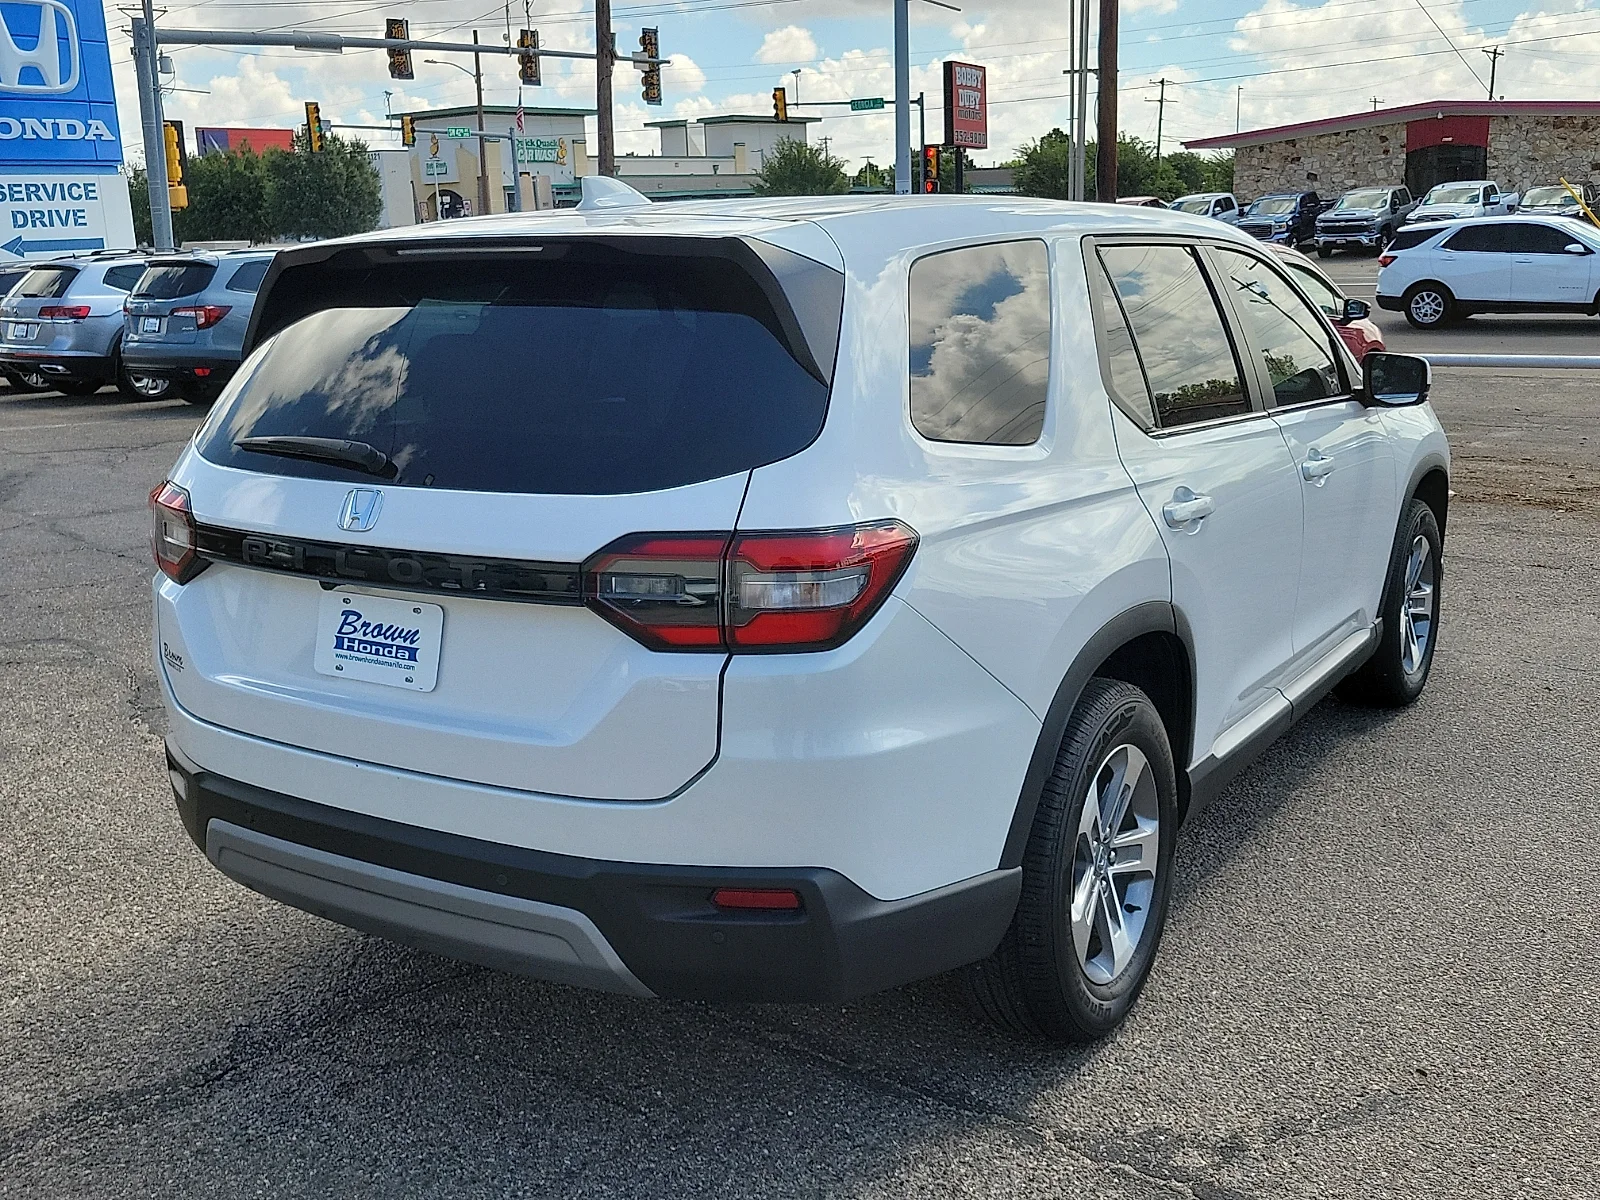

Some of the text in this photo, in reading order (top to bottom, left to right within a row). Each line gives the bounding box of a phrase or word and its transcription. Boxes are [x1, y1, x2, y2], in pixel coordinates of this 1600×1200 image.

[955, 66, 983, 89] BOBBY
[957, 88, 981, 110] DUBY
[0, 117, 116, 140] ONDA
[534, 148, 558, 161] WASH
[11, 209, 87, 229] DRIVE
[242, 537, 487, 589] PILOT
[336, 609, 421, 645] Brown
[343, 637, 410, 660] Honda
